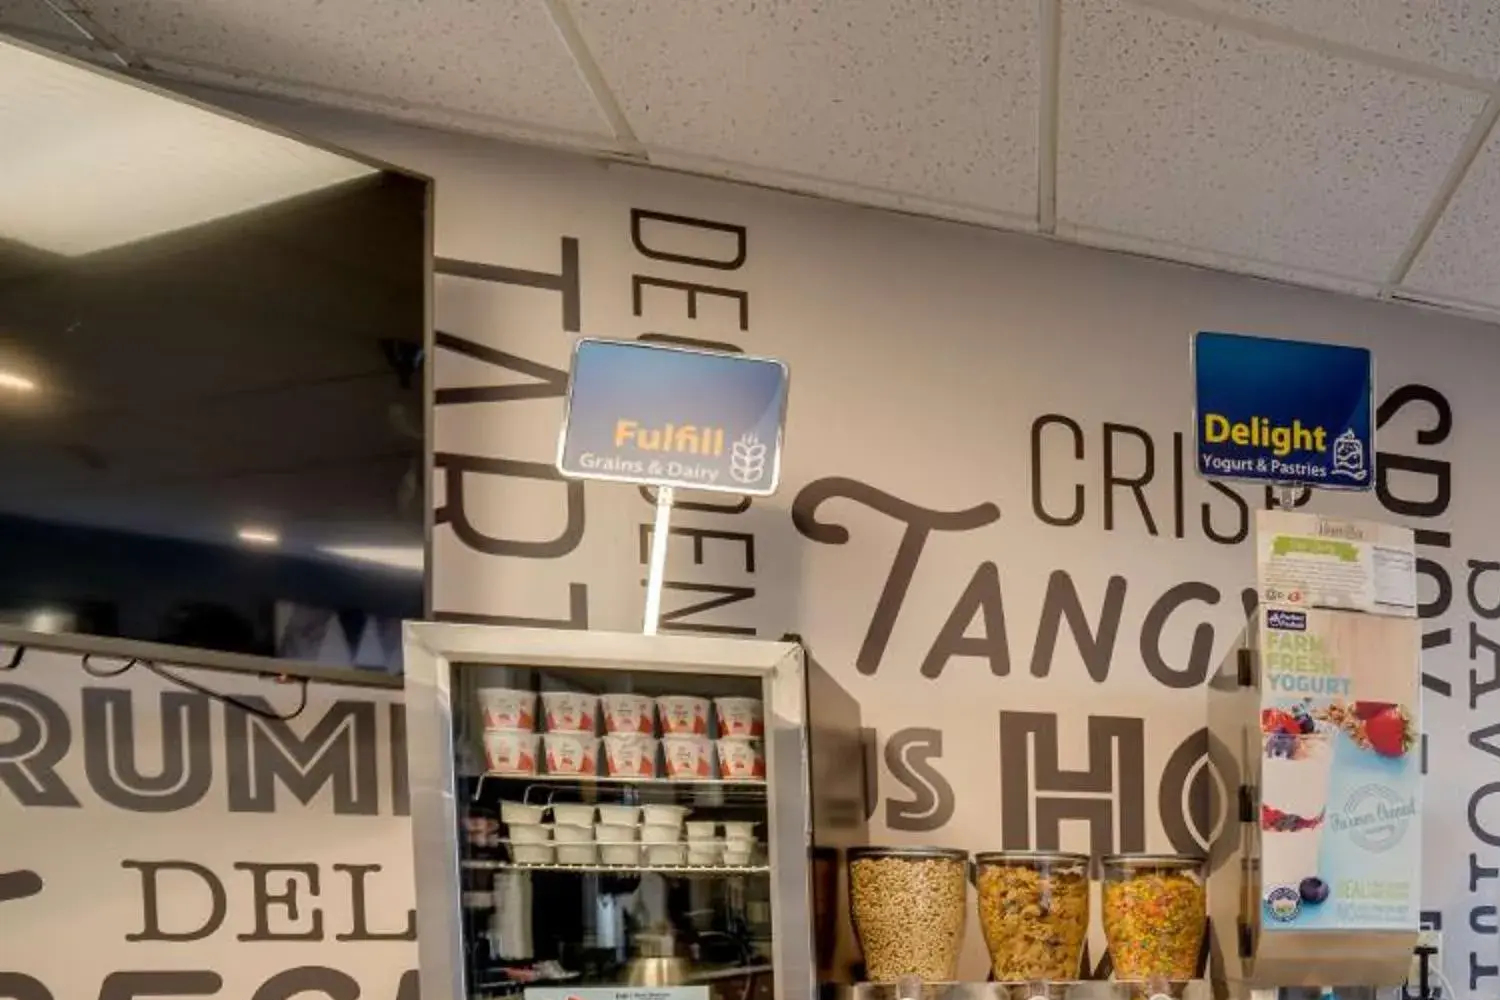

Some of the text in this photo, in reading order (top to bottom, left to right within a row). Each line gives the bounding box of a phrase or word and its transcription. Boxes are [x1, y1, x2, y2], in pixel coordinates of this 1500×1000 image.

[613, 417, 725, 458] Fulfill
[1204, 413, 1328, 457] Delight
[579, 452, 719, 482] Grains & Dairy
[1030, 413, 1313, 546] CRIS
[1203, 453, 1328, 478] Yogurt & Pastries
[792, 476, 1259, 689] TANG
[1267, 652, 1336, 675] FRESH
[1267, 674, 1352, 696] YOGURT
[0, 684, 412, 817] RUM
